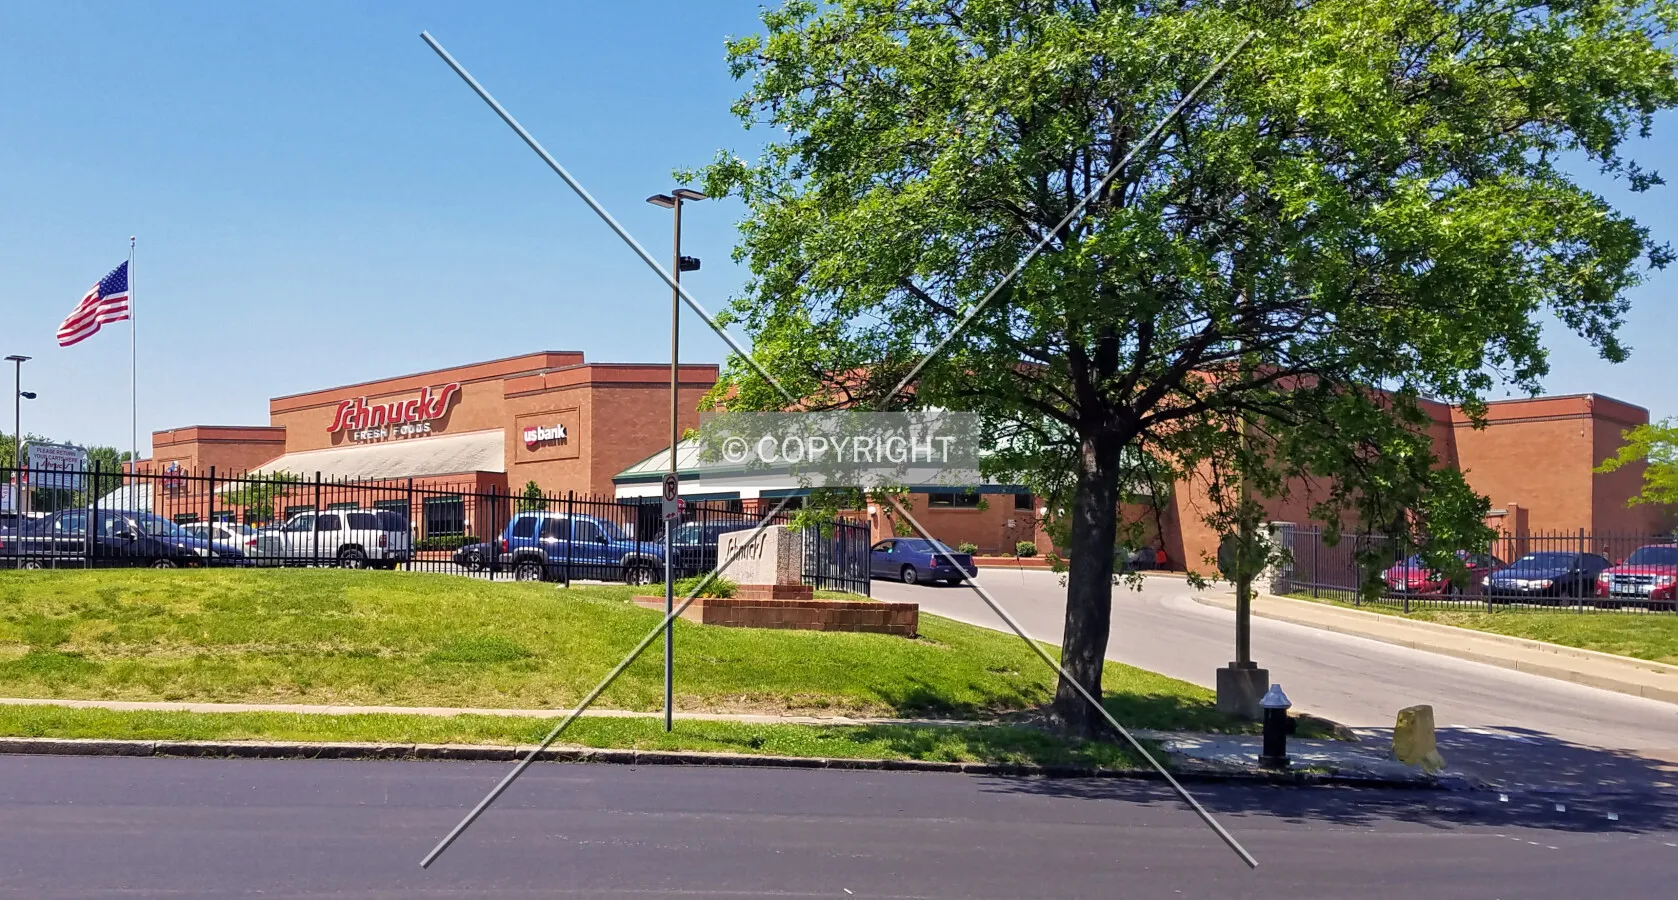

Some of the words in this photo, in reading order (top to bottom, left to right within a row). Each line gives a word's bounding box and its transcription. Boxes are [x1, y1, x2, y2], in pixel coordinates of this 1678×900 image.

[327, 383, 460, 432] Schnucks
[354, 428, 388, 440] FRESH
[393, 422, 430, 436] FOODS
[41, 461, 71, 469] Shnucs
